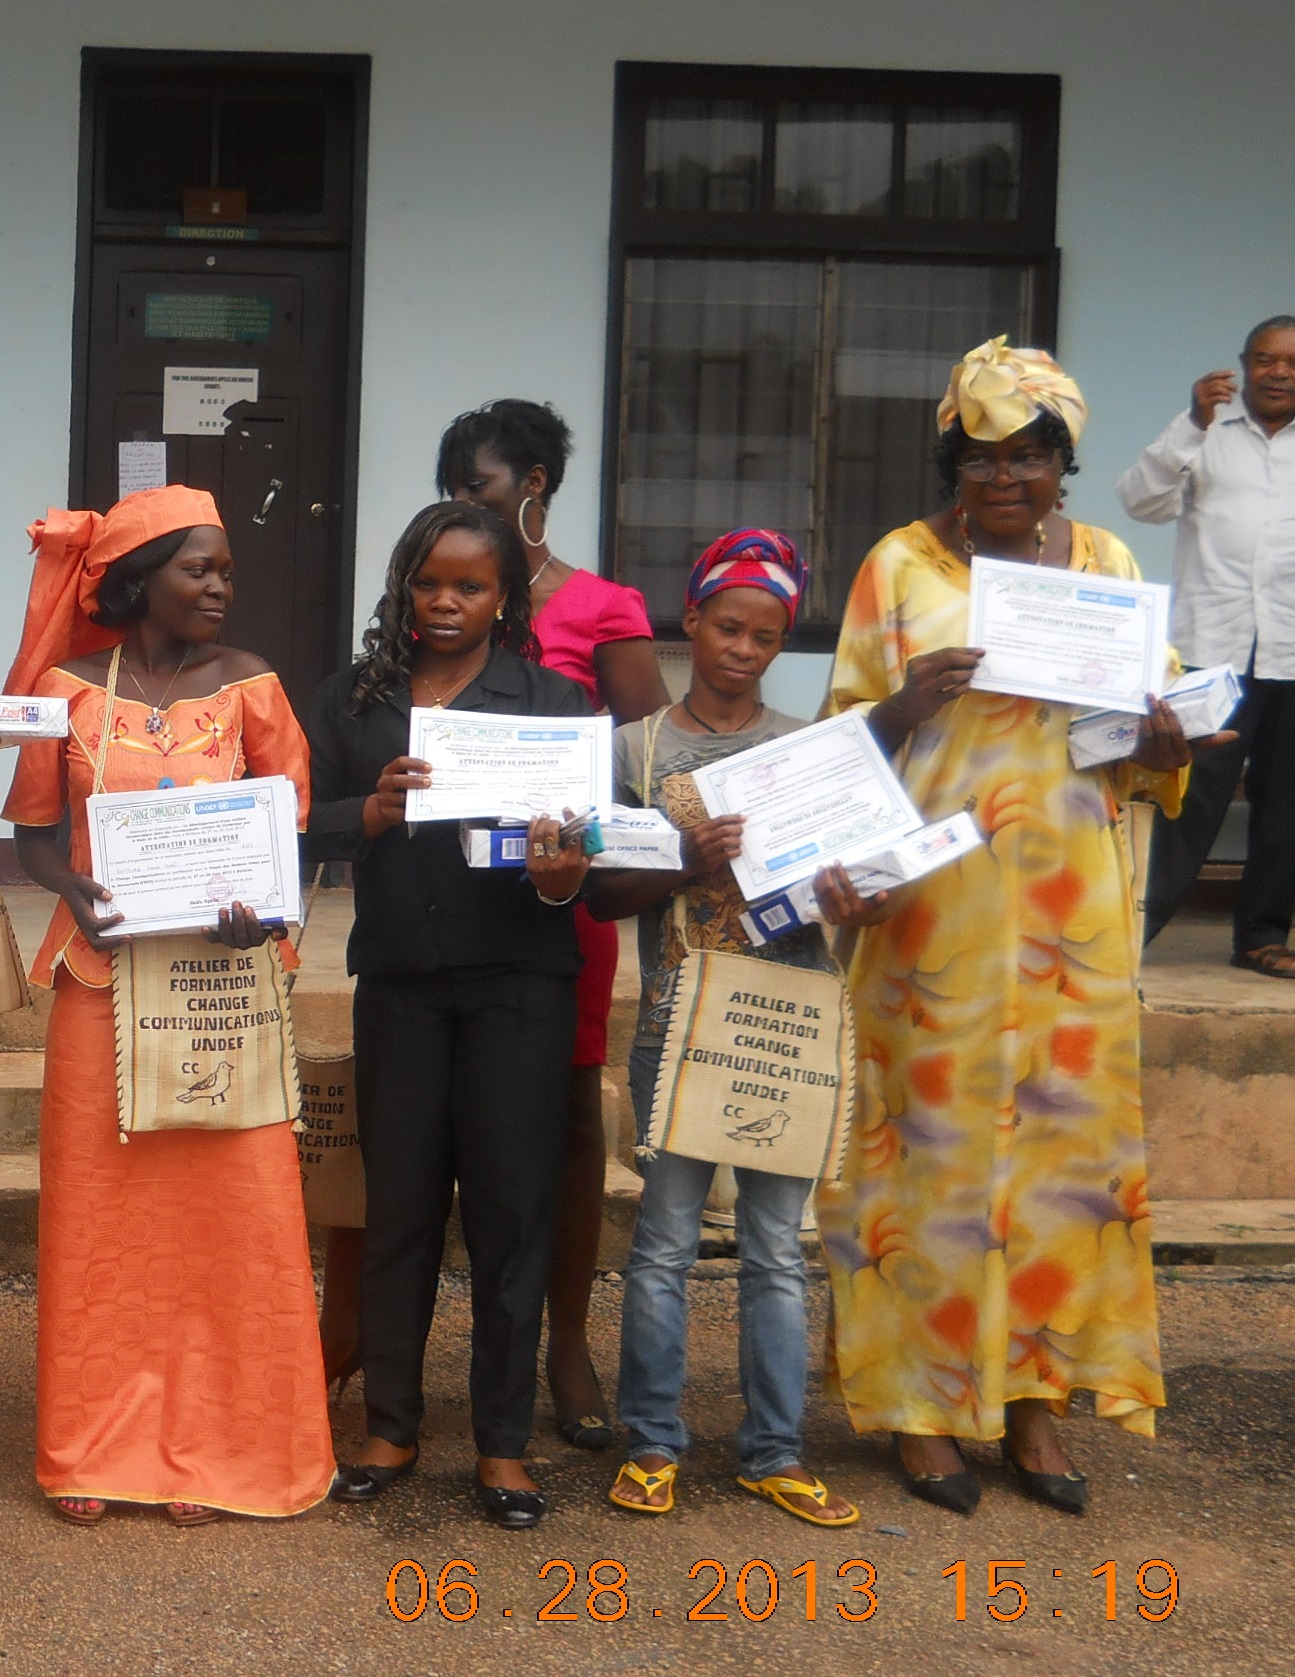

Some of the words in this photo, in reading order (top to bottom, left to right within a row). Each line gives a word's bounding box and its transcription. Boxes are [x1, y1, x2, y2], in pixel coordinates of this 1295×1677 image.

[179, 227, 244, 239] DIRECTION
[130, 808, 149, 821] CHANGE
[150, 803, 190, 820] COMMUNICATIONS
[196, 804, 216, 812] UNDEF
[140, 840, 187, 852] ATTESTATION
[198, 834, 240, 844] FORMATION
[170, 958, 230, 972] ATELIER
[236, 956, 254, 970] DE
[170, 975, 256, 992] FORMATION
[186, 996, 250, 1012] CHANGE
[730, 991, 797, 1014] ATELIER
[803, 1005, 822, 1020] DE
[139, 1008, 280, 1030] COMMUNICATIONS
[724, 1011, 819, 1040] FORMATION
[192, 1036, 244, 1052] UNDEF
[734, 1034, 802, 1059] CHANGE
[181, 1062, 200, 1074] CC
[684, 1047, 837, 1088] COMMUNICATIONS
[732, 1080, 790, 1103] UNDEF
[301, 1102, 344, 1114] ATION
[723, 1104, 746, 1119] CC
[298, 1151, 324, 1164] DEF
